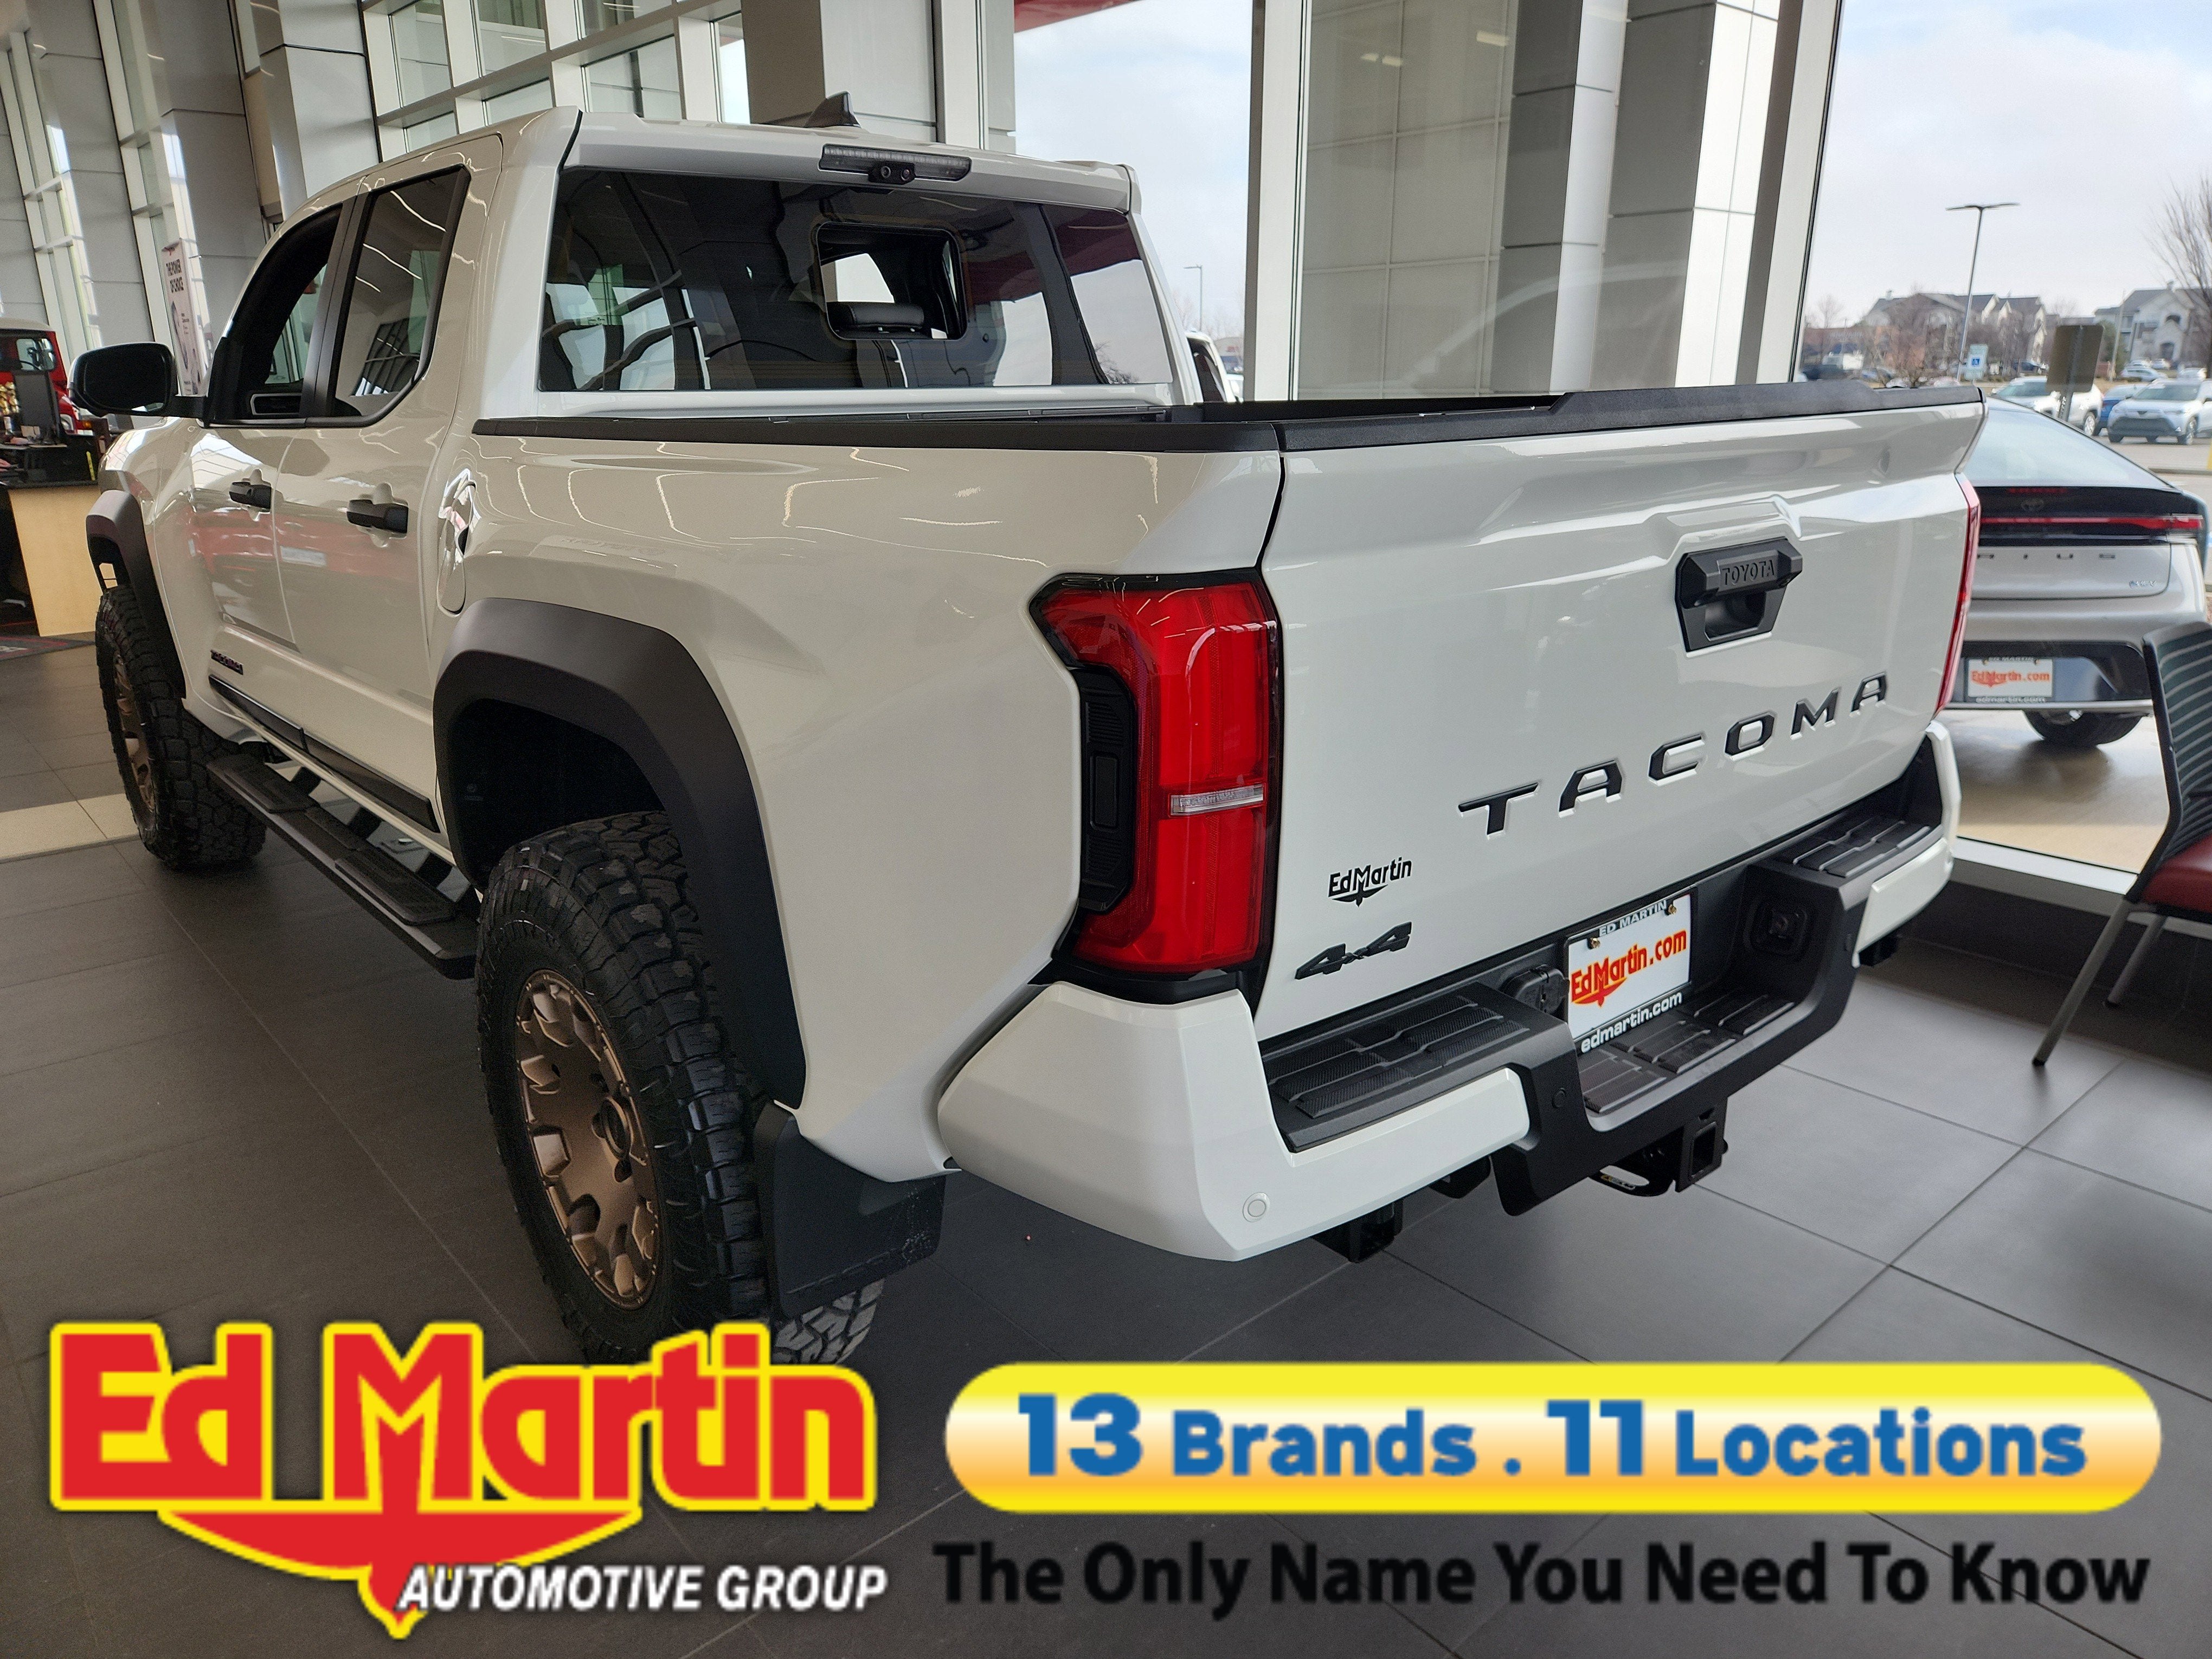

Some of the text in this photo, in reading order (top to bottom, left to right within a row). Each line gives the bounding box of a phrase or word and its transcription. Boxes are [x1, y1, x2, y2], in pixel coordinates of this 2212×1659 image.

[1722, 560, 1774, 586] TOYOTA
[1457, 671, 1889, 837] TACOMA
[1599, 899, 1668, 938] ED MARTIN
[1294, 921, 1412, 980] 4x4
[1570, 929, 1688, 1004] EdMartin.com
[1580, 991, 1683, 1054] edmartin.com
